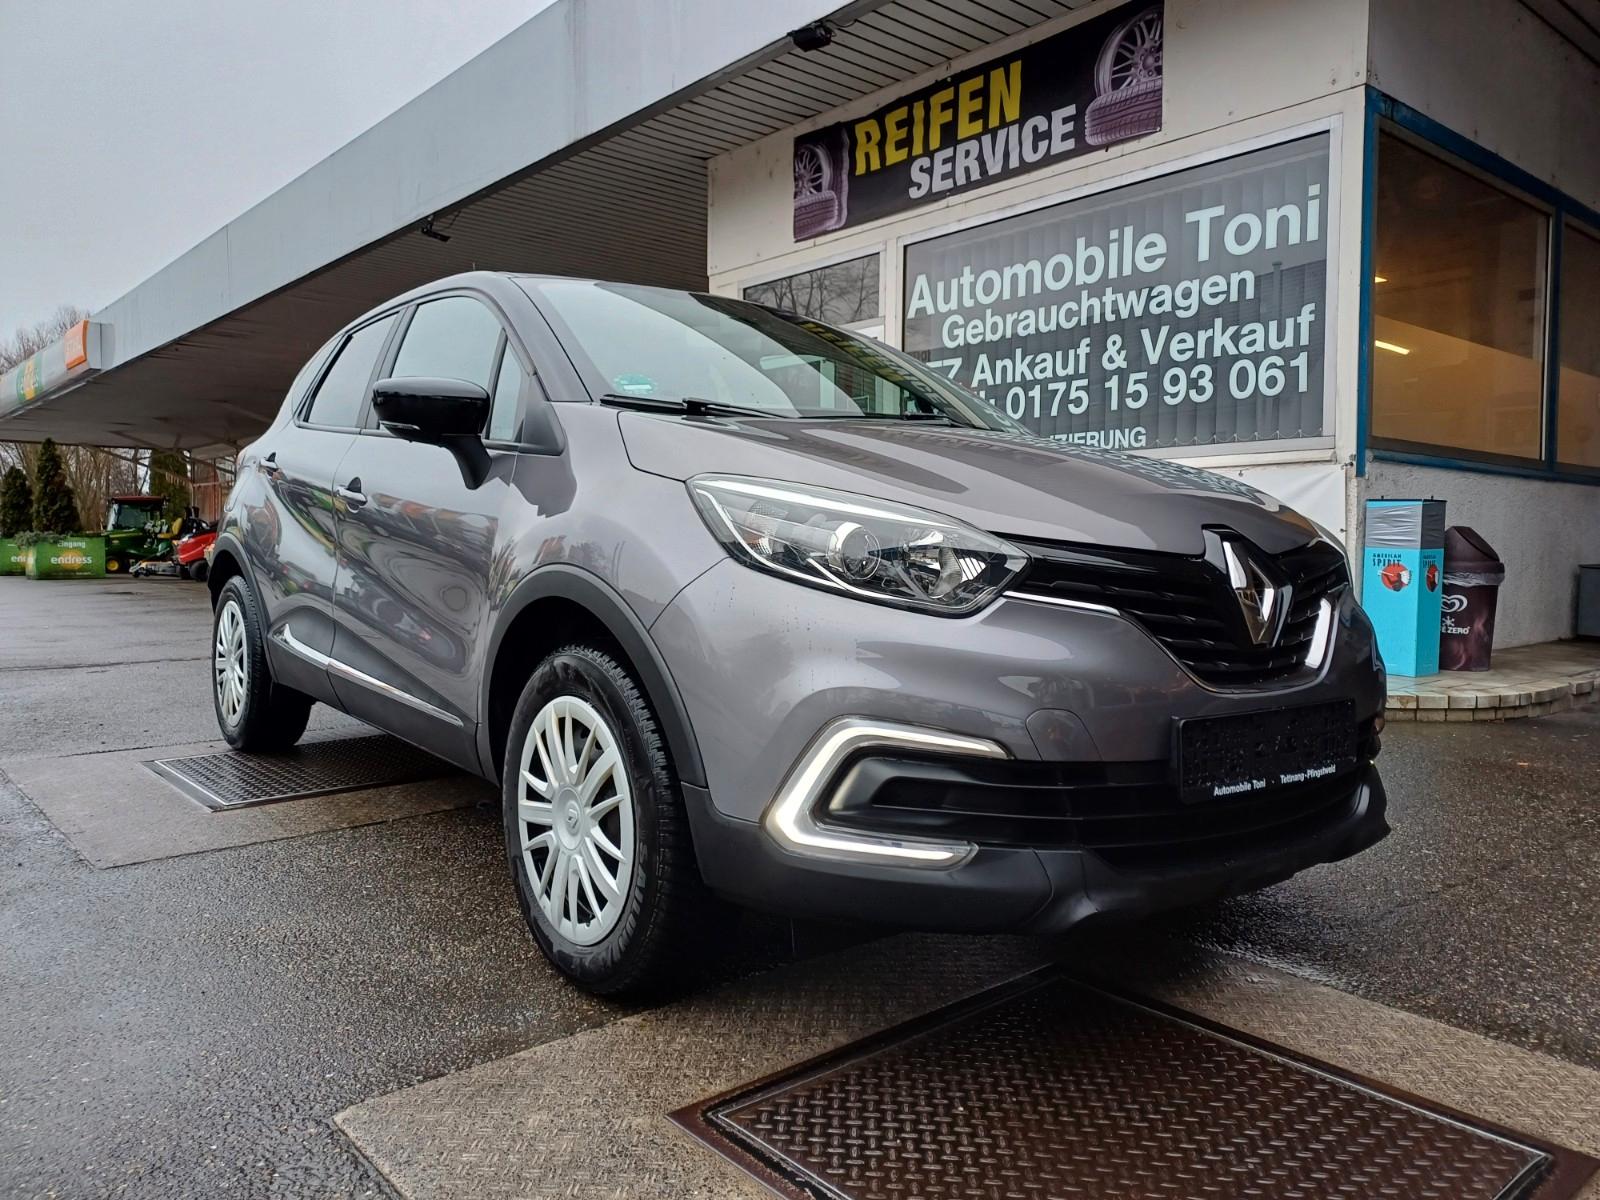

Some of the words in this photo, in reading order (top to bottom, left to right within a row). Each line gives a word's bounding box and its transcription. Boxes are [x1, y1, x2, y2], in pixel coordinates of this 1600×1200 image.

[855, 60, 1022, 176] REIFEN
[909, 104, 1077, 200] SERVICE
[907, 225, 1168, 319] Automobile
[1185, 183, 1321, 262] Toni
[942, 269, 1256, 349] Gebrauchtwagen
[971, 337, 1091, 388] Ankauf
[1101, 334, 1128, 371] &
[1141, 303, 1317, 365] Verkauf
[1006, 378, 1090, 420] 0175
[1104, 371, 1150, 411] 15
[1163, 364, 1214, 406] 93
[1229, 352, 1309, 400] 061
[50, 554, 92, 565] endress
[1372, 558, 1402, 567] SPIRIT
[1213, 781, 1251, 796] Automobile
[1252, 778, 1266, 789] Toni
[619, 841, 648, 952] SAILUN
